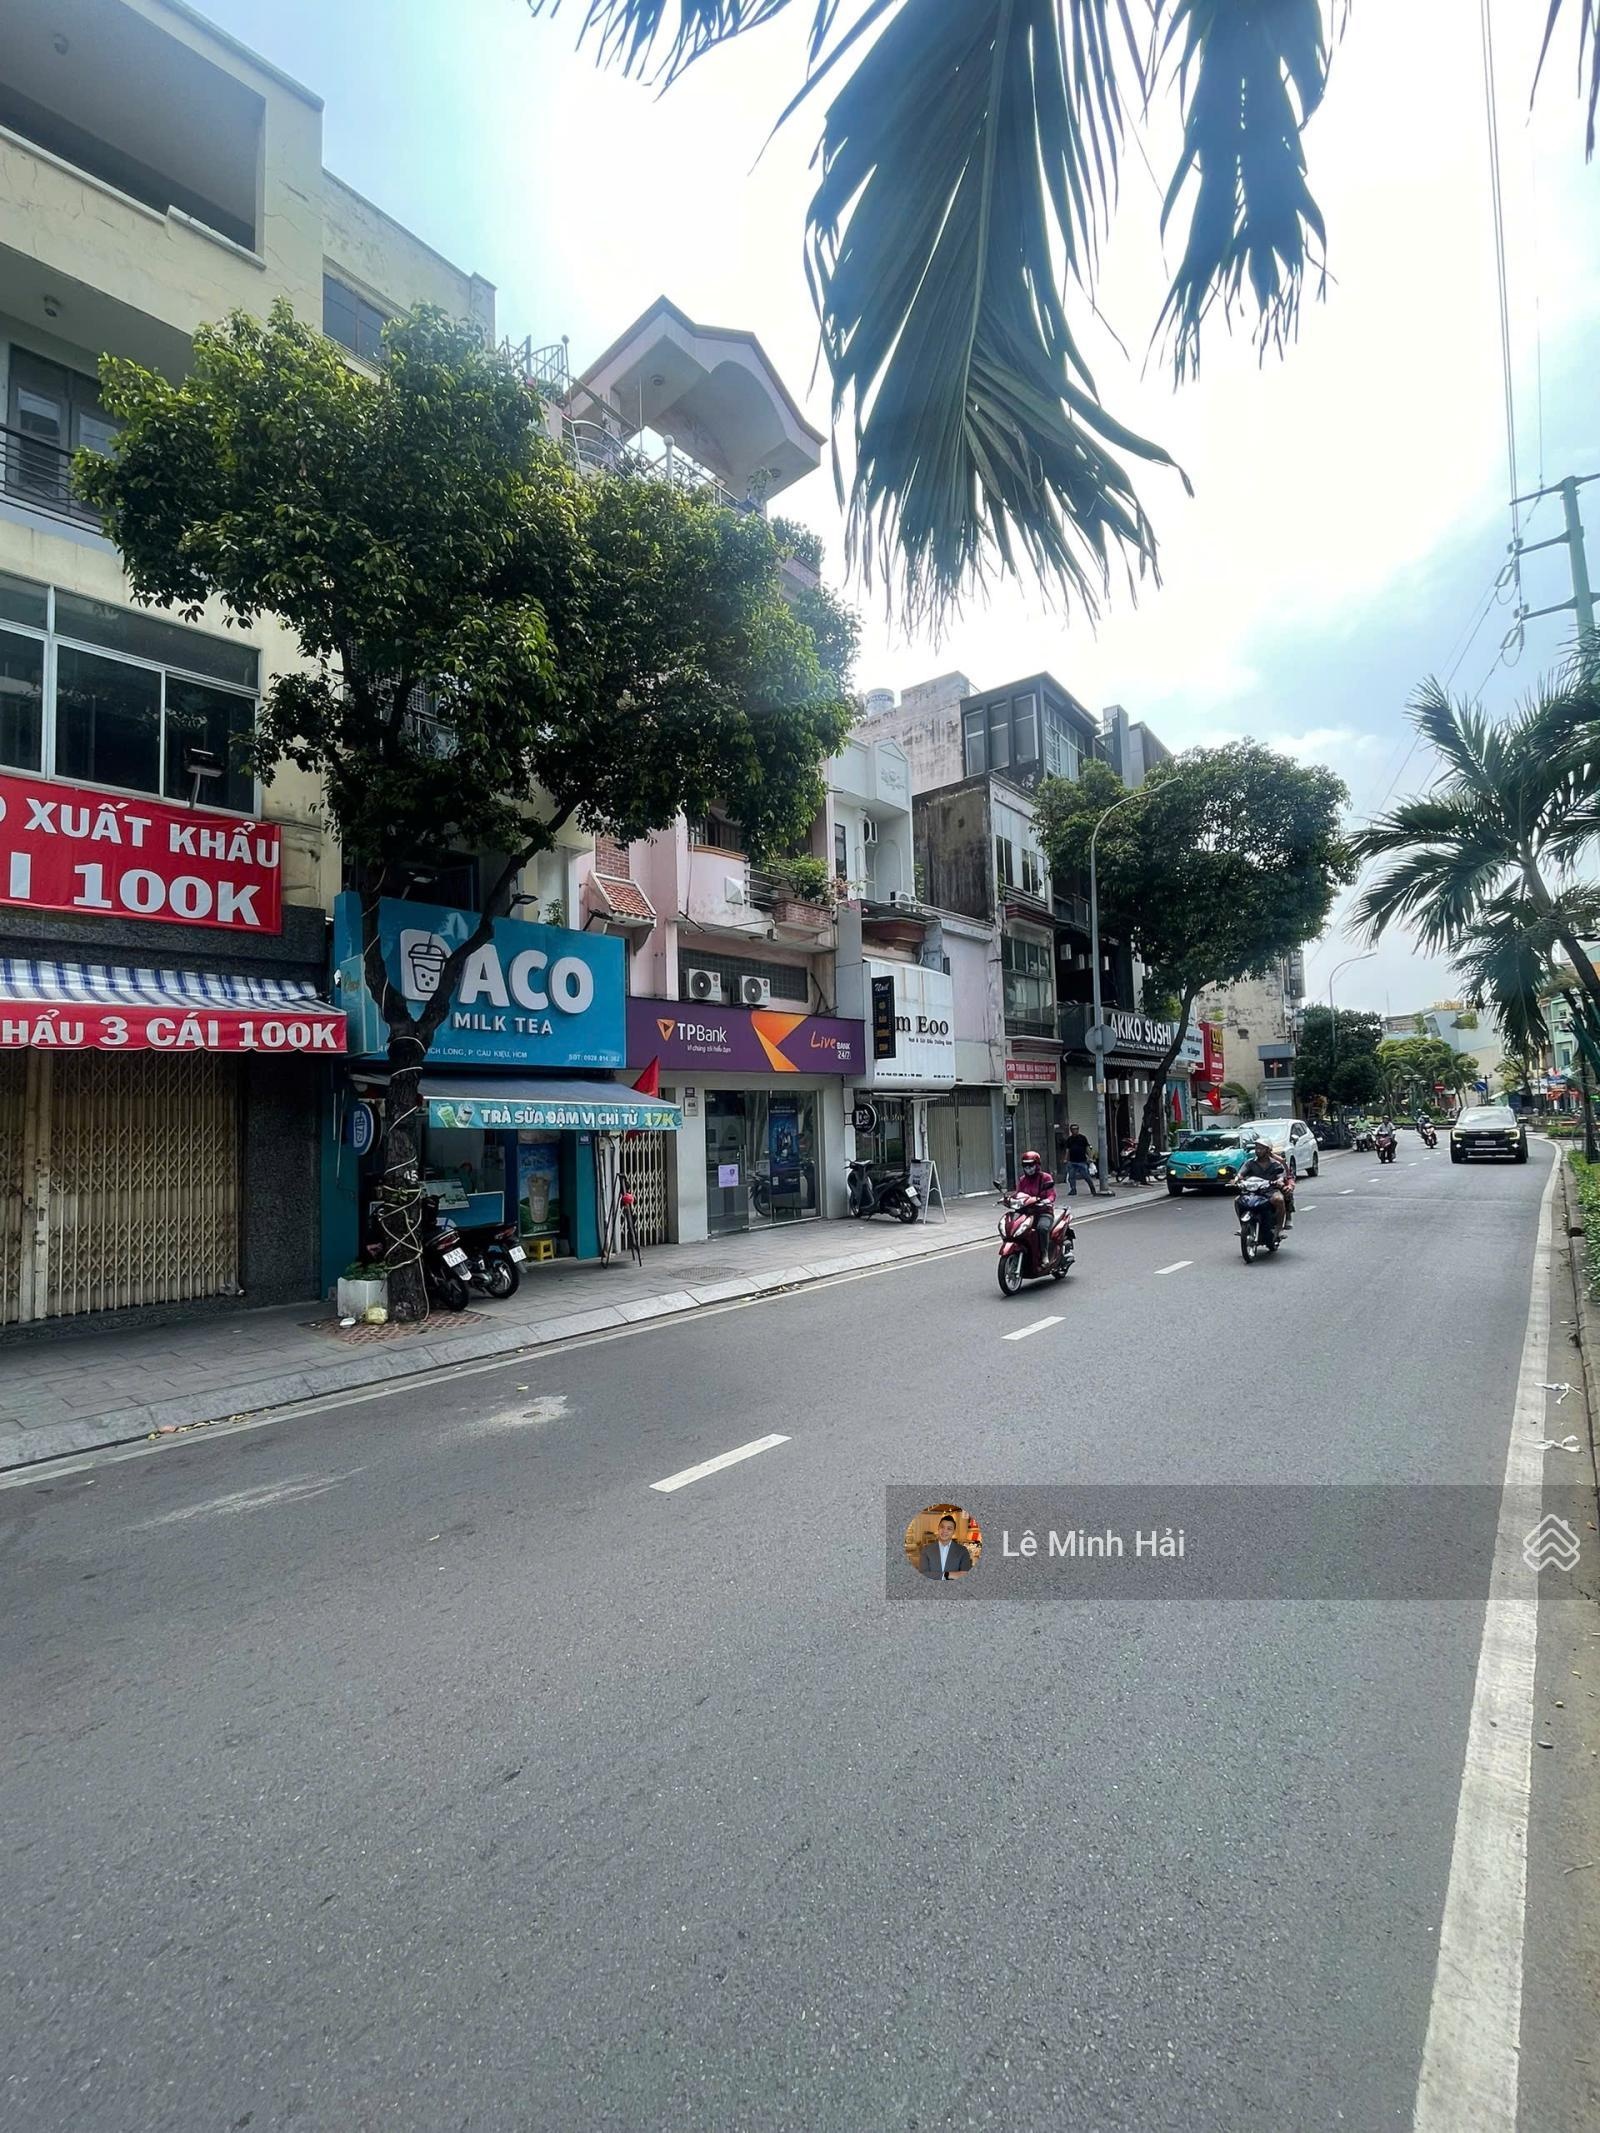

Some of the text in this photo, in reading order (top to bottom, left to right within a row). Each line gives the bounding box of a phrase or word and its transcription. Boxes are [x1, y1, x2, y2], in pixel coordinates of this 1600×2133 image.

[24, 797, 152, 848] XUẤT
[169, 821, 280, 869] KHẨU
[73, 863, 261, 926] 100K
[1, 1008, 337, 1048] HẨU 3 CÁI 100K
[453, 1011, 554, 1035] MILK TEA
[677, 1022, 727, 1043] TPBank
[916, 1016, 949, 1035] Eoo
[1110, 1012, 1172, 1046] AKIKO SUSHI
[810, 1030, 837, 1050] Live
[836, 1042, 851, 1050] BANK
[481, 1106, 512, 1123] TRÀ
[514, 1106, 544, 1124] SỮA
[546, 1107, 580, 1127] ĐẬM
[582, 1112, 595, 1128] VỊ
[622, 1110, 638, 1126] TỪ
[644, 1112, 676, 1127] 17K
